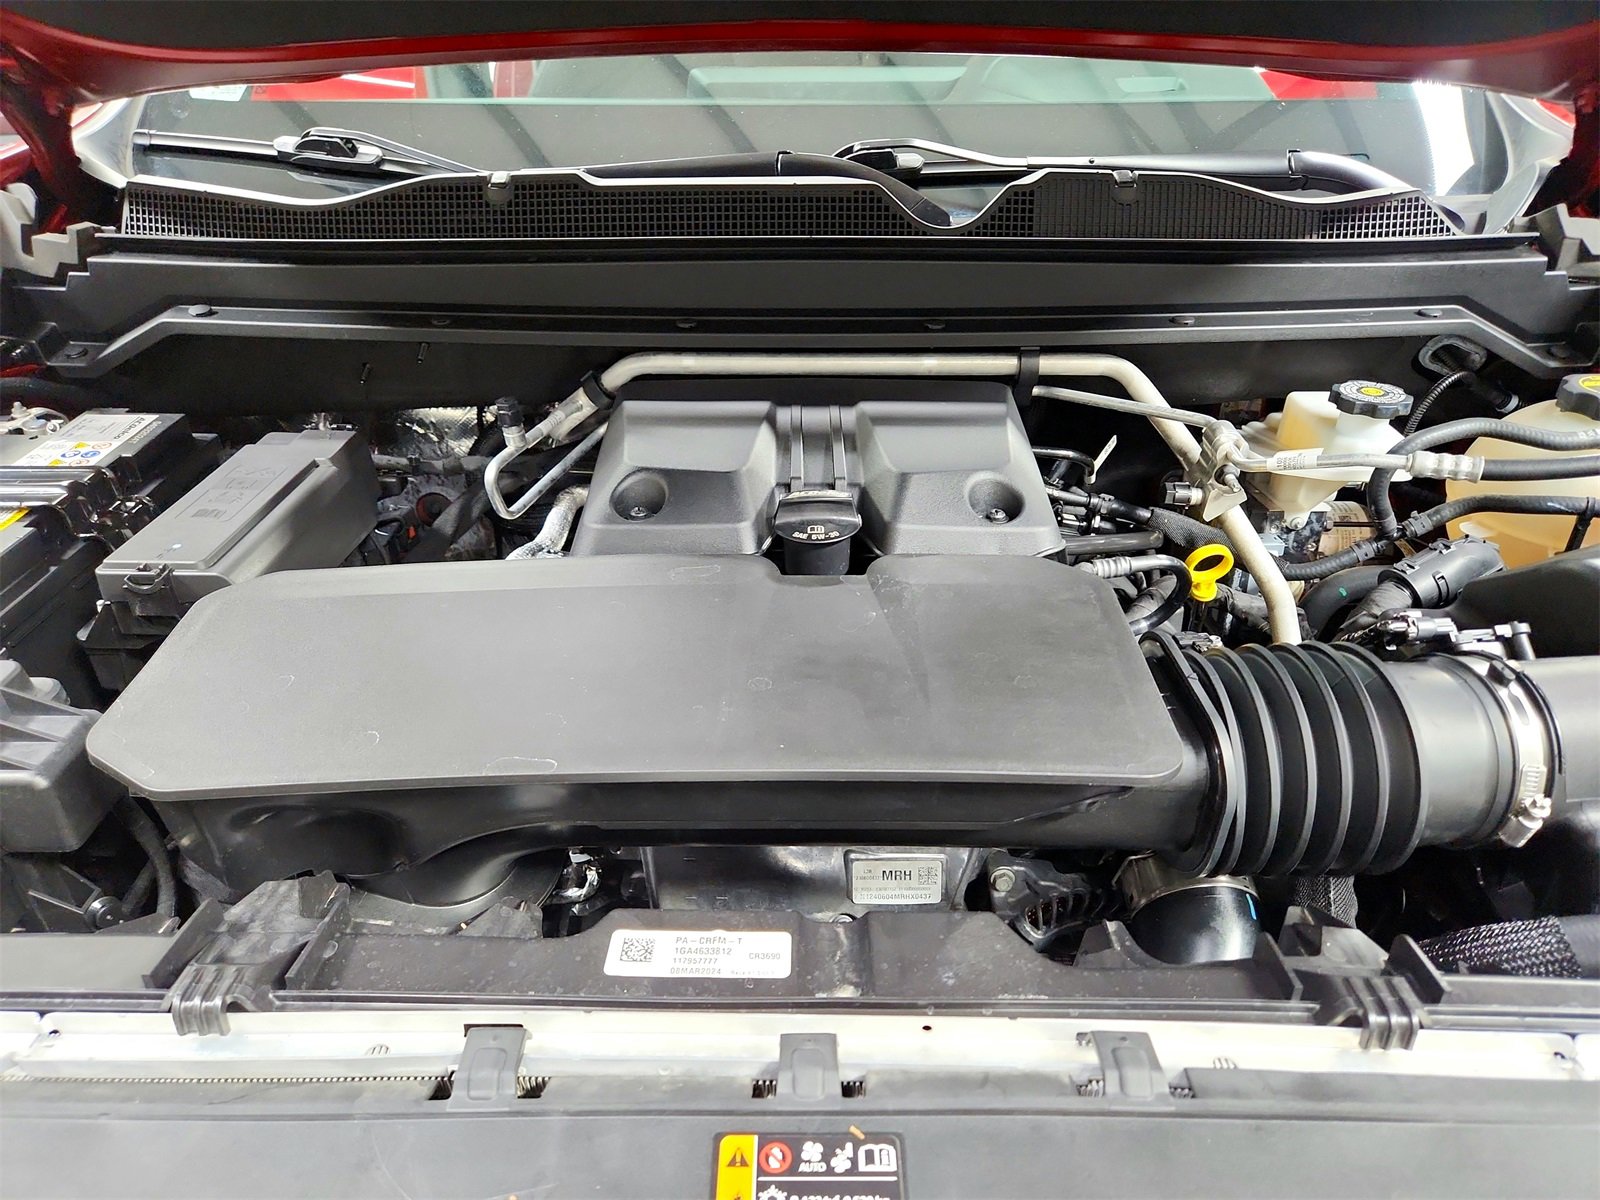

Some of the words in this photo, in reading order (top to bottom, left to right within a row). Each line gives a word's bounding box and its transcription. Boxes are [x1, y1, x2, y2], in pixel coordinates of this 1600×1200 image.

[792, 531, 809, 540] SAE
[882, 870, 912, 881] MRH
[748, 952, 781, 960] CR3690
[670, 967, 722, 975] 08MAR2024
[798, 1161, 827, 1172] AUTO
